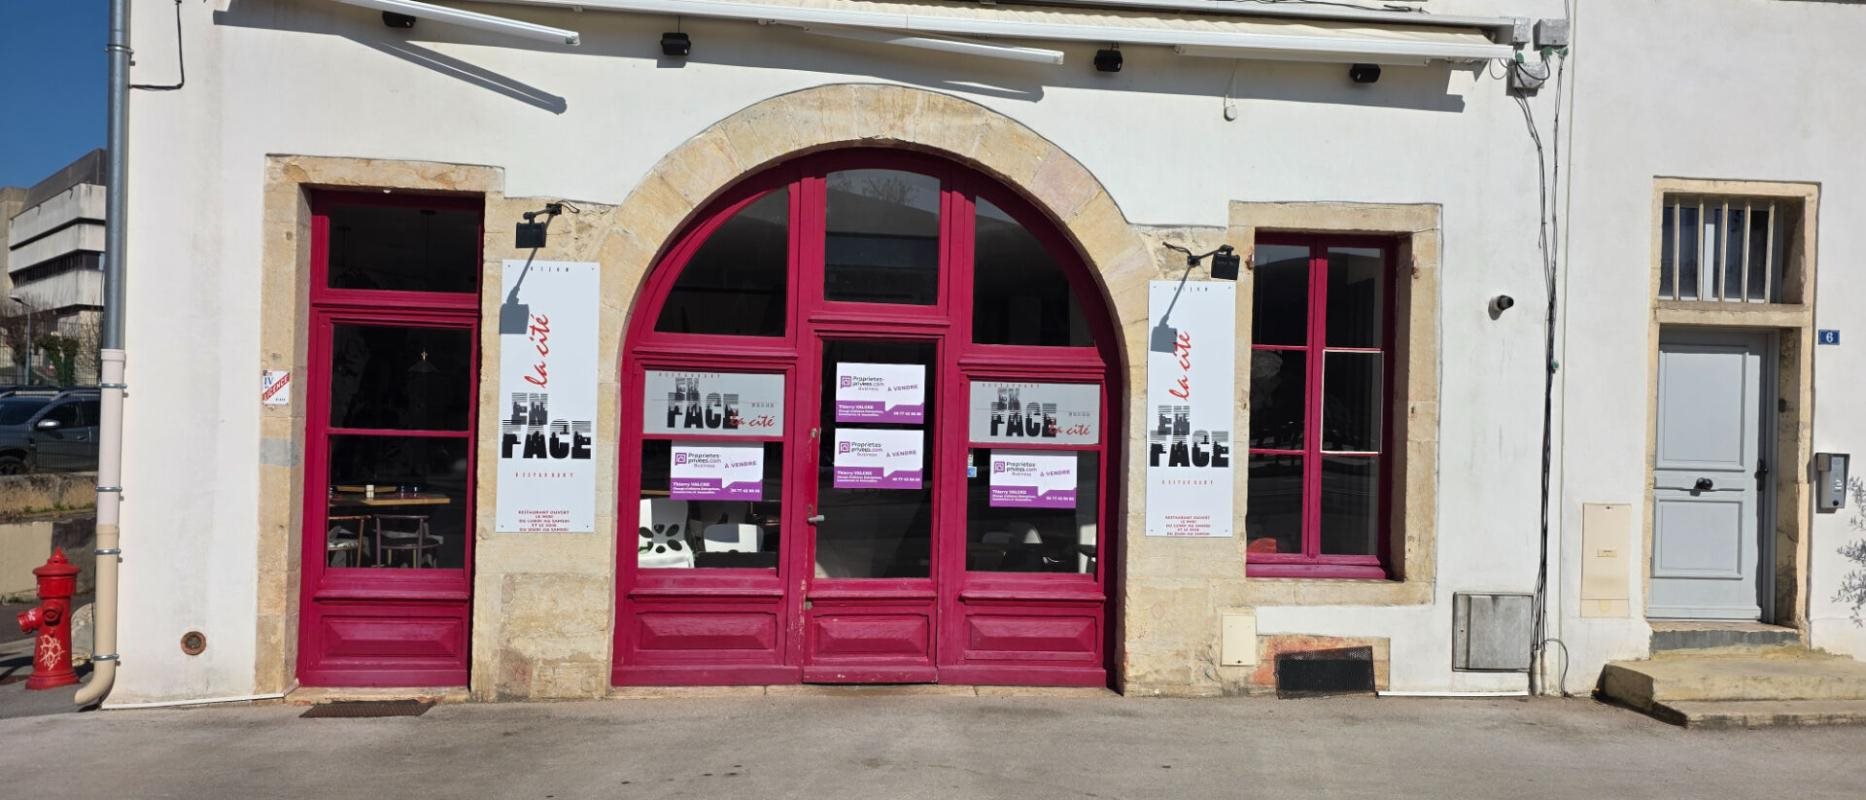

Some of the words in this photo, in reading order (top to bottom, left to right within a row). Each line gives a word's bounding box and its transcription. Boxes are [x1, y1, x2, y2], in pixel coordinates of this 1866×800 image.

[529, 313, 550, 357] cité
[1826, 331, 1834, 343] 6
[524, 361, 548, 389] la
[675, 377, 701, 402] EN
[1169, 374, 1190, 402] la
[511, 392, 549, 426] EN
[667, 392, 740, 431] FACE
[749, 415, 777, 428] cité
[991, 402, 1057, 438] FACE
[1157, 405, 1190, 436] EN
[501, 418, 592, 461] FACE
[1066, 424, 1091, 436] cité
[1149, 429, 1230, 468] FACE
[732, 460, 758, 468] VENDRE
